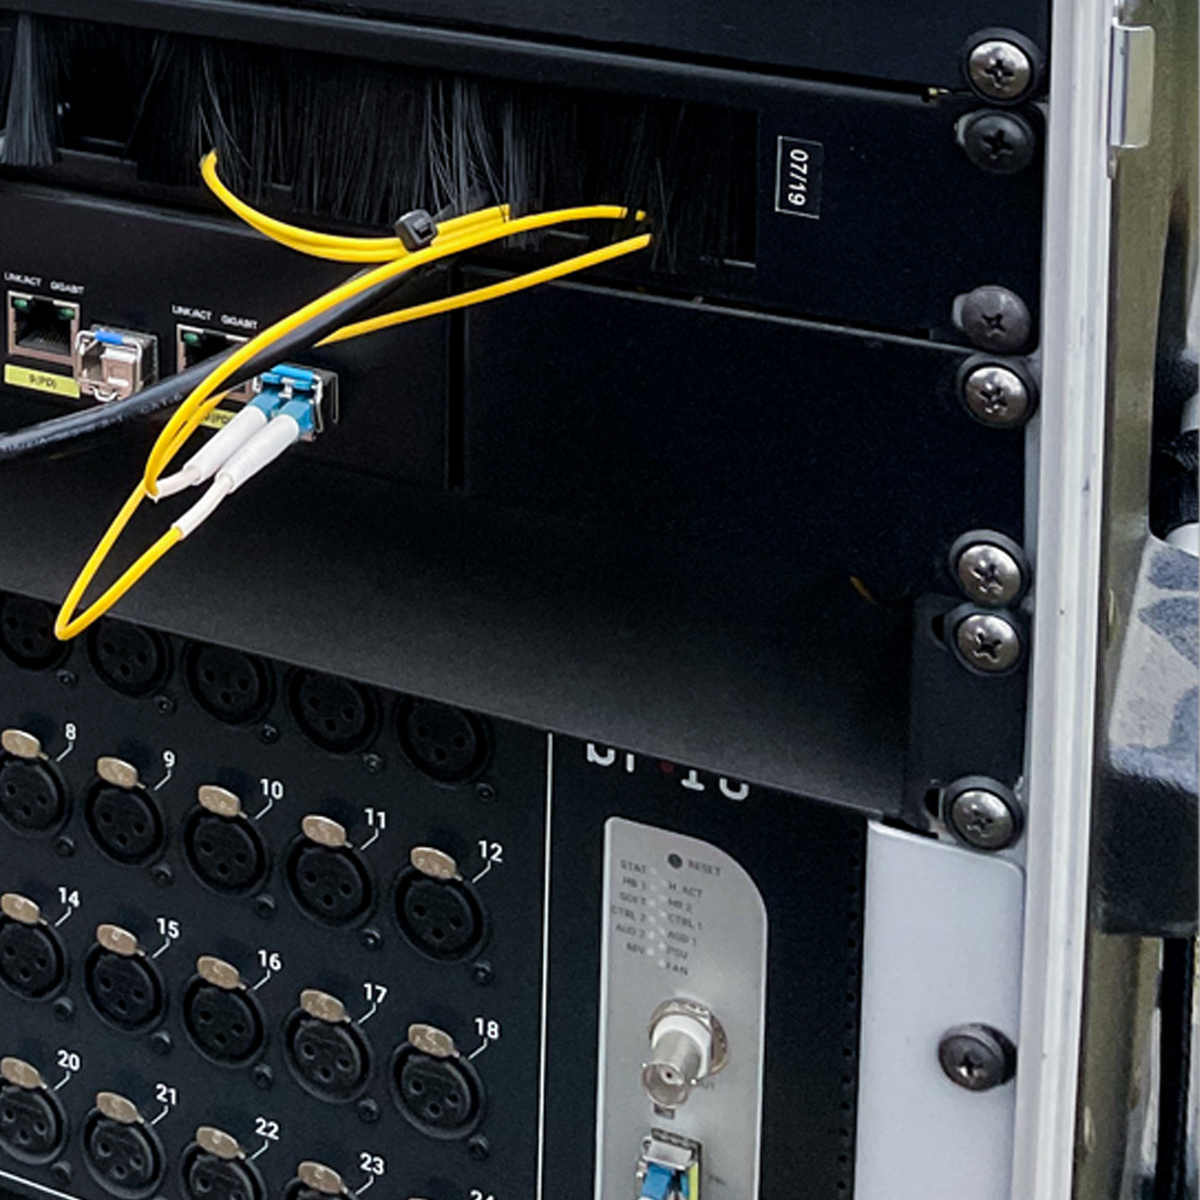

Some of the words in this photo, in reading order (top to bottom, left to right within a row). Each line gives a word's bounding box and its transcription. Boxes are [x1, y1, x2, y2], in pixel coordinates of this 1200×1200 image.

[787, 149, 809, 206] 07/19
[65, 723, 76, 740] 8
[163, 750, 176, 768] 9
[260, 778, 284, 799] 10
[363, 807, 387, 830] 11
[477, 840, 504, 863] 12
[58, 887, 80, 908] 14
[156, 918, 180, 939] 15
[257, 950, 282, 971] 16
[363, 982, 388, 1004] 17
[474, 1017, 499, 1040] 18
[57, 1049, 81, 1071] 20
[155, 1083, 178, 1105] 21
[254, 1116, 280, 1141] 22
[359, 1152, 385, 1176] 23
